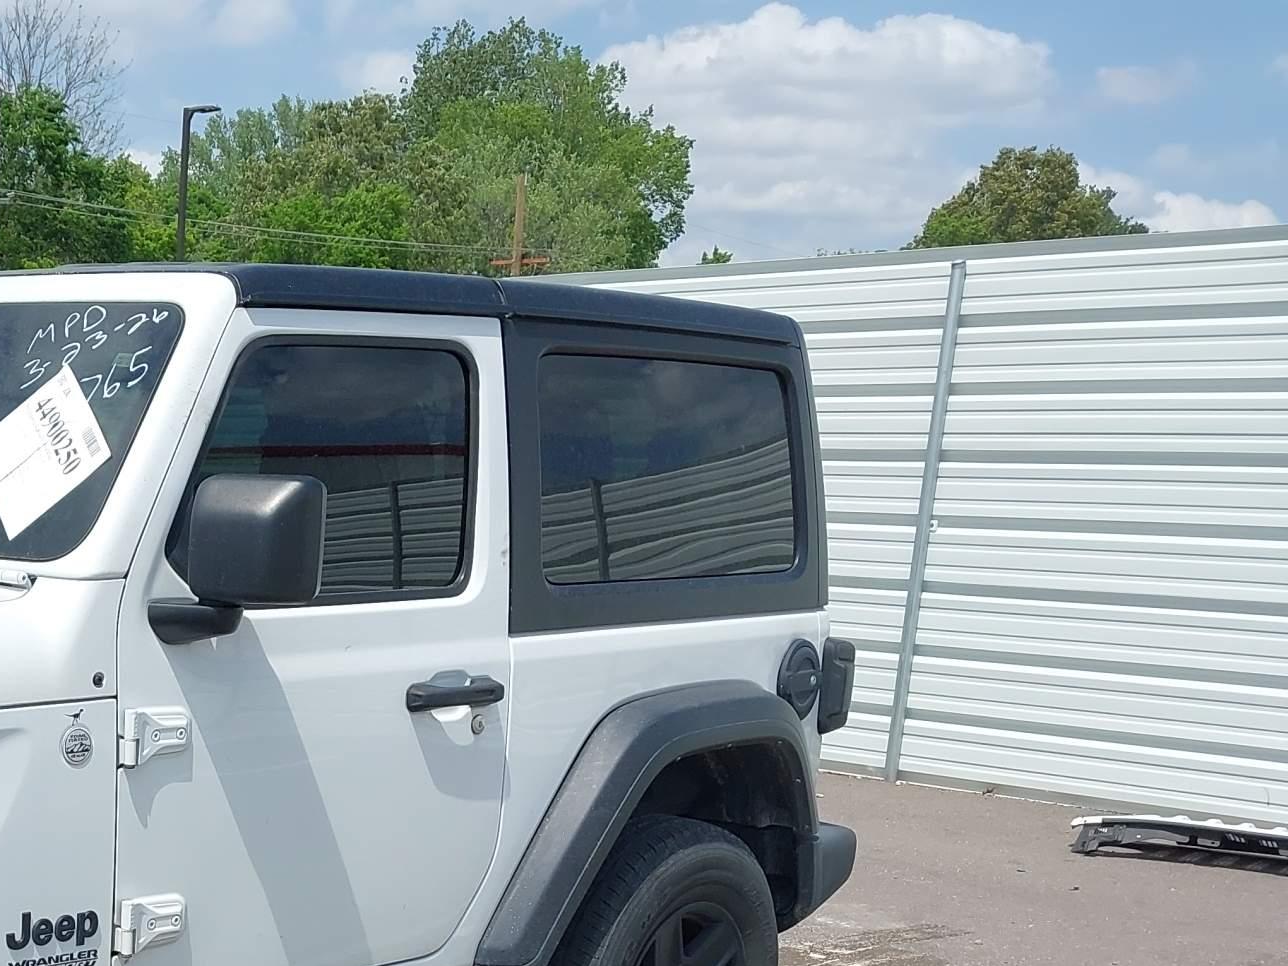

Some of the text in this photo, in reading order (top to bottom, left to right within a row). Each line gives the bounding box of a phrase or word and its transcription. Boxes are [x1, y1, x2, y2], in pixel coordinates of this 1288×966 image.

[27, 305, 107, 354] MPD
[35, 397, 81, 475] 44900250
[5, 910, 99, 951] Jeep
